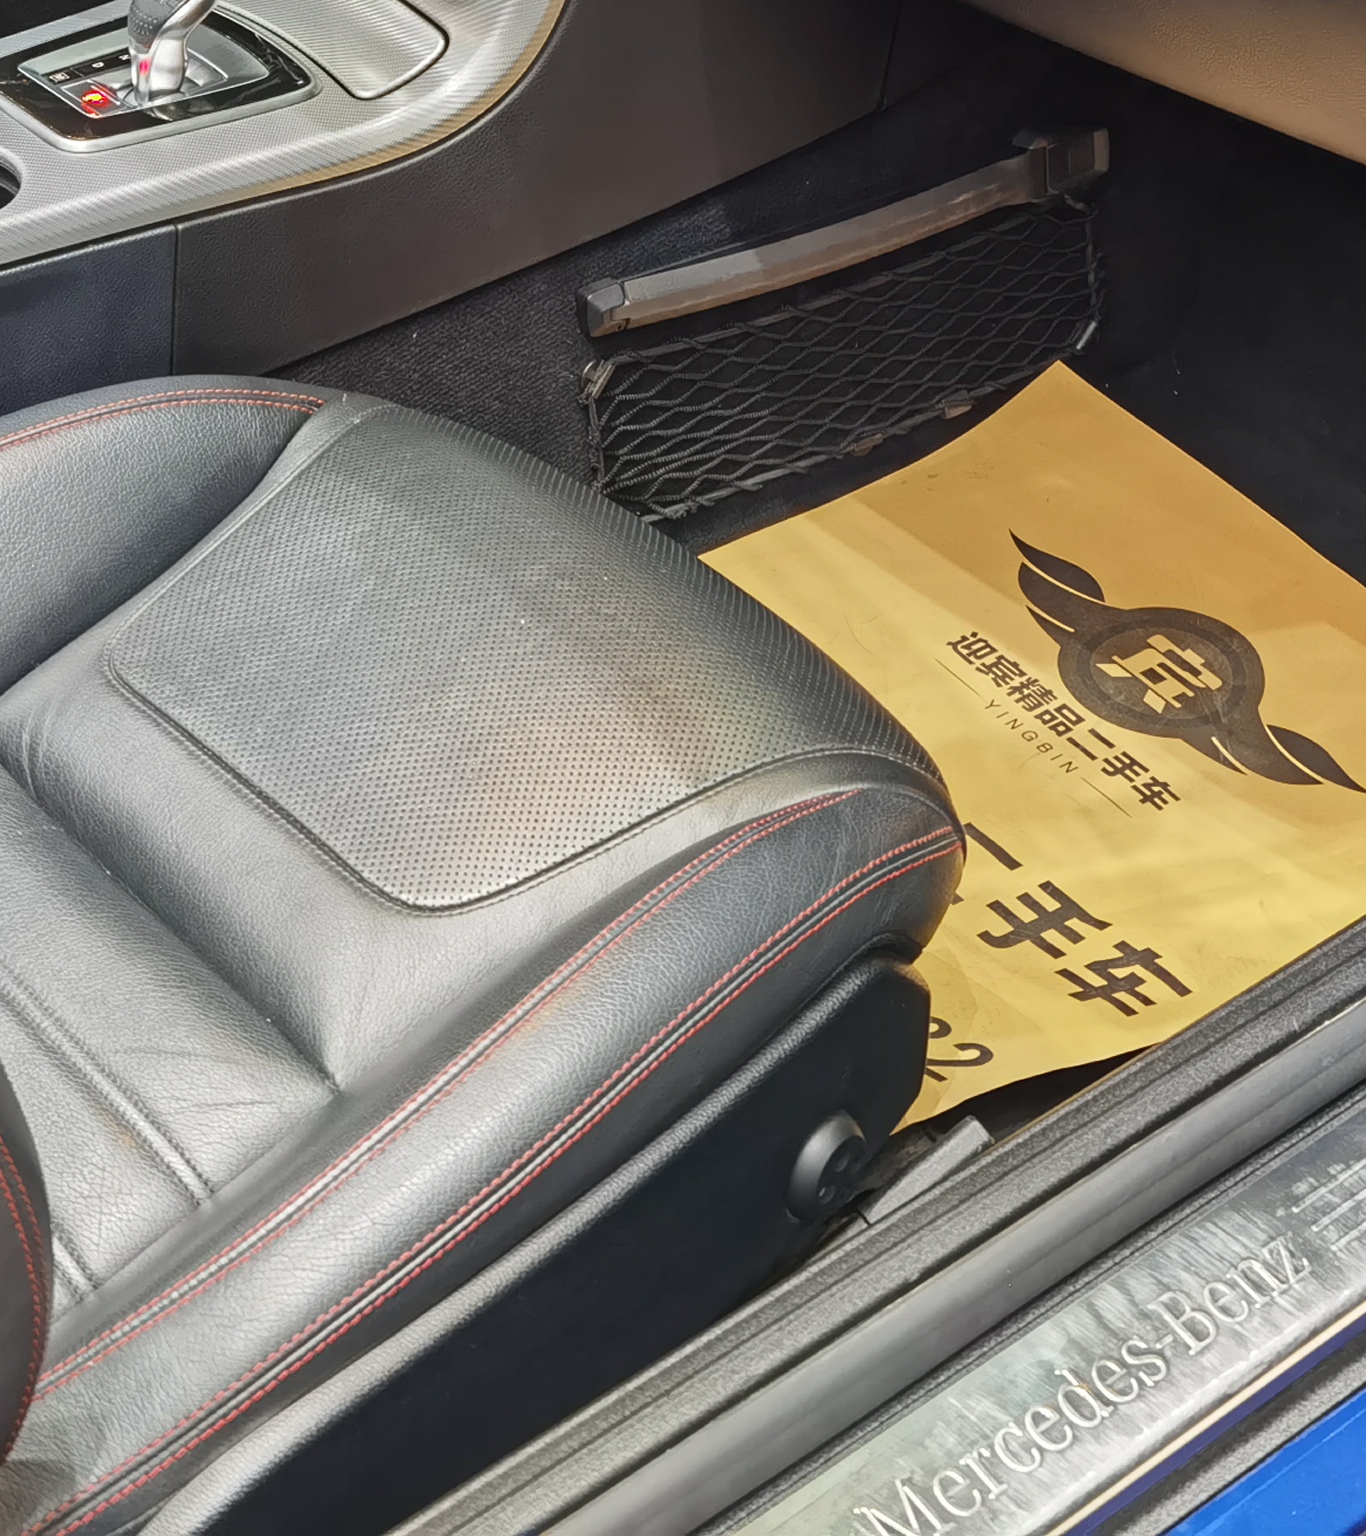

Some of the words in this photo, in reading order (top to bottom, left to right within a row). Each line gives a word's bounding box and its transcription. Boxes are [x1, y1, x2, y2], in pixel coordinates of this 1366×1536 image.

[946, 631, 1182, 811] 迎宾精品二手车
[984, 699, 1079, 774] YINGBIN
[853, 1236, 1312, 1536] Mercedes-Benz
